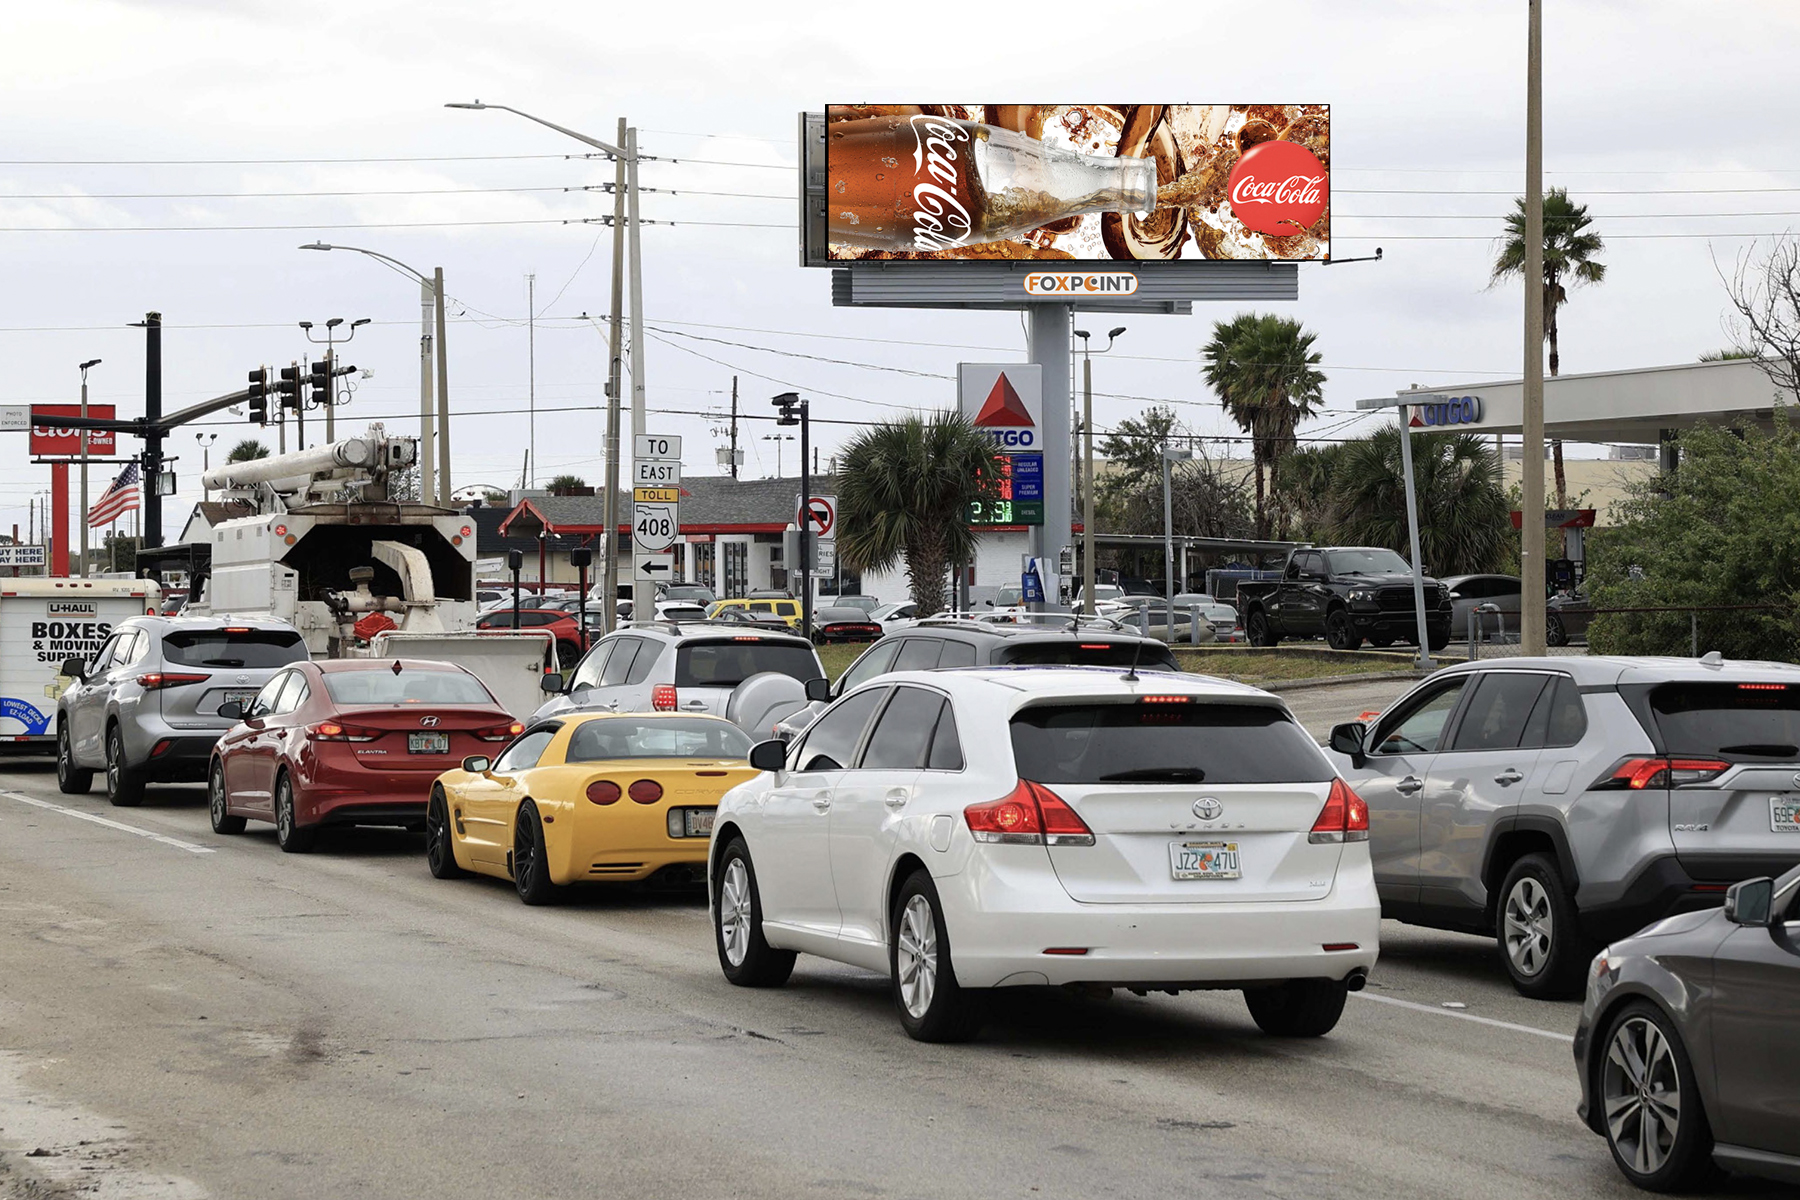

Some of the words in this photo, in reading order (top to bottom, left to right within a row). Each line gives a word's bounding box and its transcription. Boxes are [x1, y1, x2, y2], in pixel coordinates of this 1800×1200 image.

[1232, 175, 1326, 204] Coca-Cola
[1029, 276, 1134, 292] FOXPOINT
[647, 439, 668, 455] TO
[641, 465, 673, 480] EAST
[642, 490, 671, 500] TOLL
[637, 519, 669, 536] 408
[50, 604, 94, 612] U-HAUL
[32, 622, 112, 639] BOXES
[32, 640, 44, 650] &
[50, 640, 103, 650] MOVIN
[37, 652, 97, 662] SUPPLIE
[3, 700, 28, 711] LOWEST
[27, 708, 44, 725] DECKS
[10, 708, 33, 724] EZ-LOAD
[1674, 823, 1709, 832] RAV4
